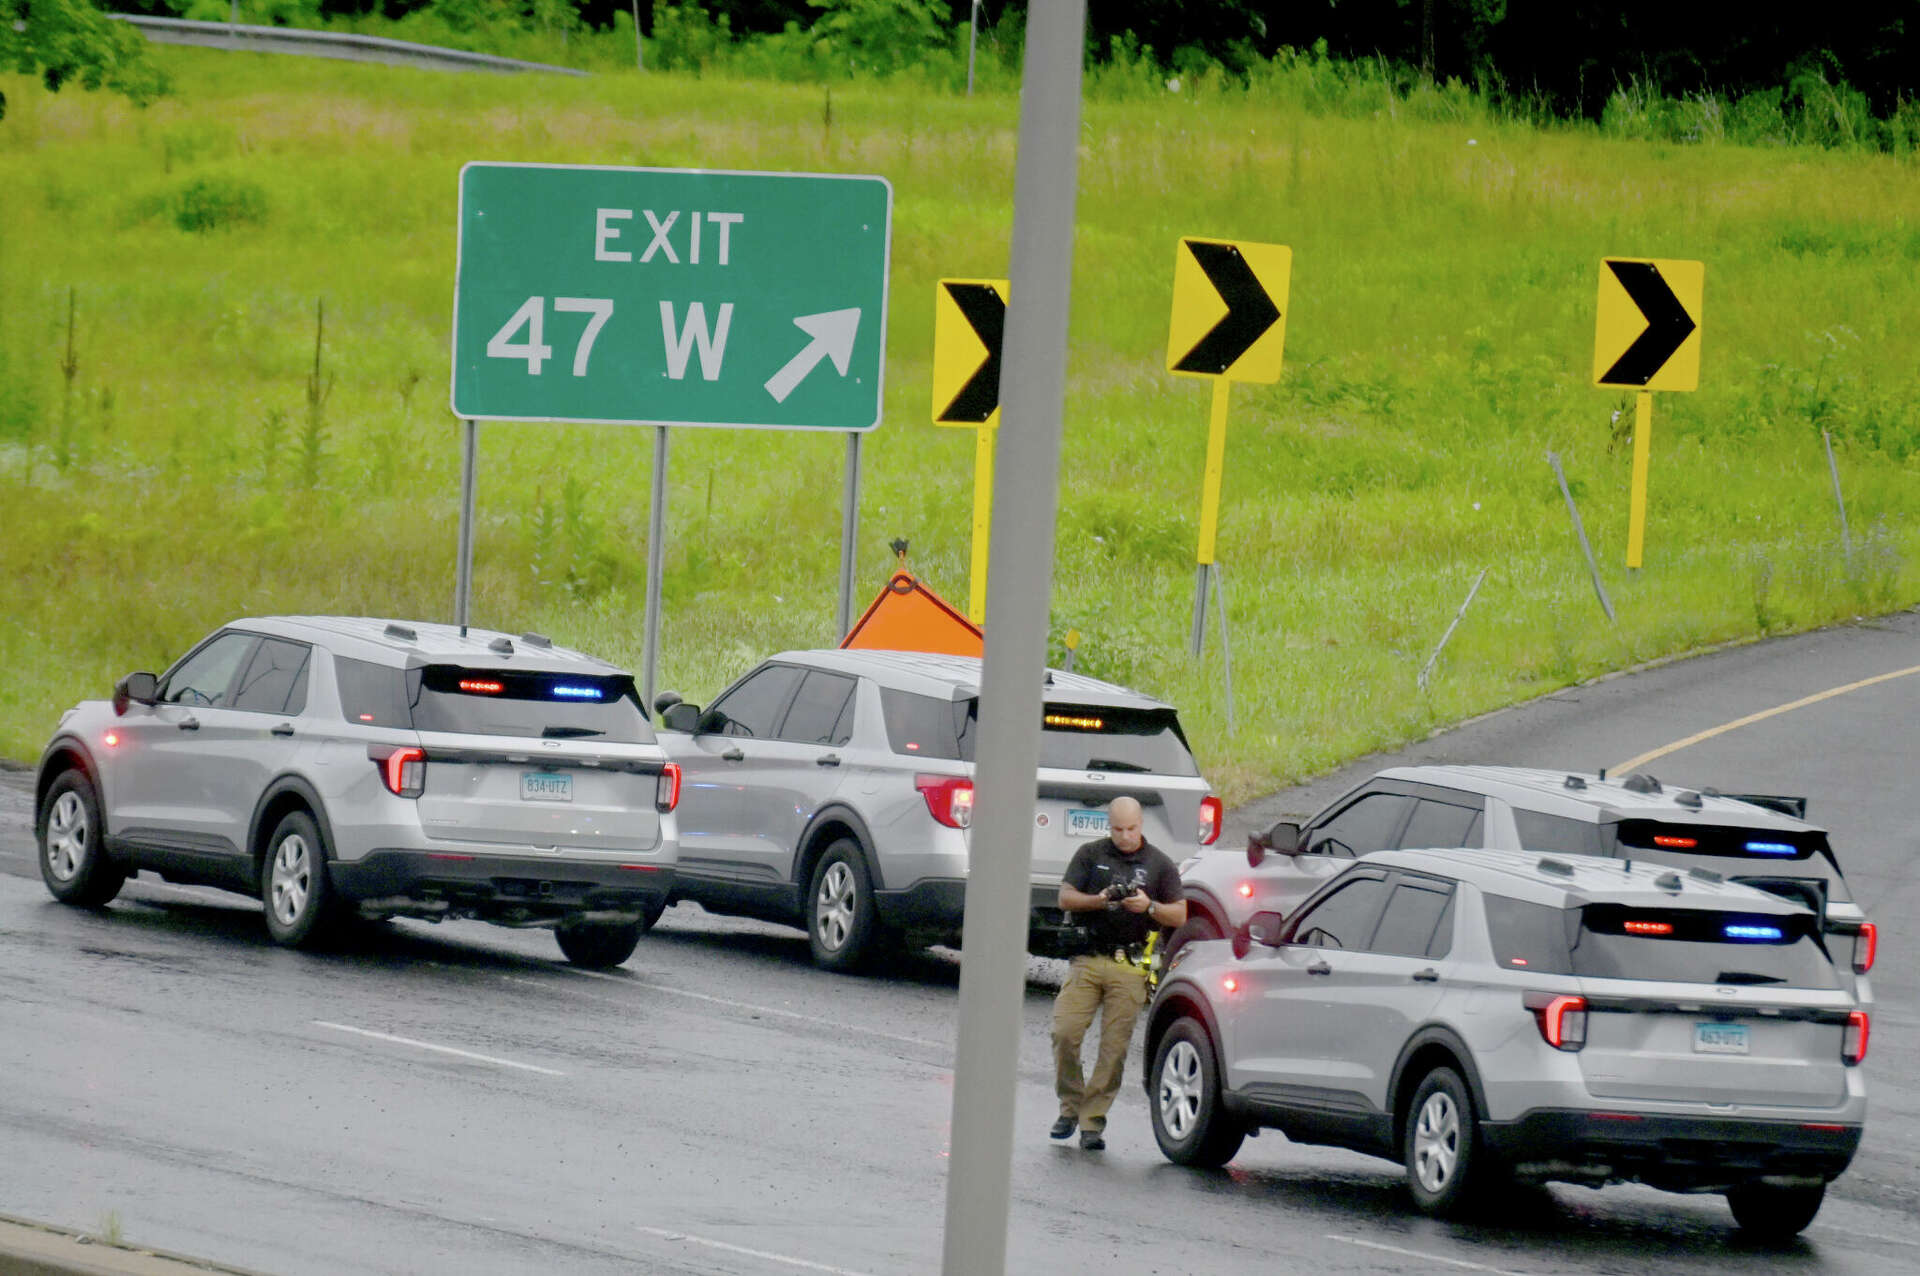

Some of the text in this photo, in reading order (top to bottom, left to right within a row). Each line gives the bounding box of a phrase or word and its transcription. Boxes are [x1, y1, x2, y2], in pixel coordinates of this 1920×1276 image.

[595, 208, 744, 265] EXIT
[487, 296, 734, 381] 47 W
